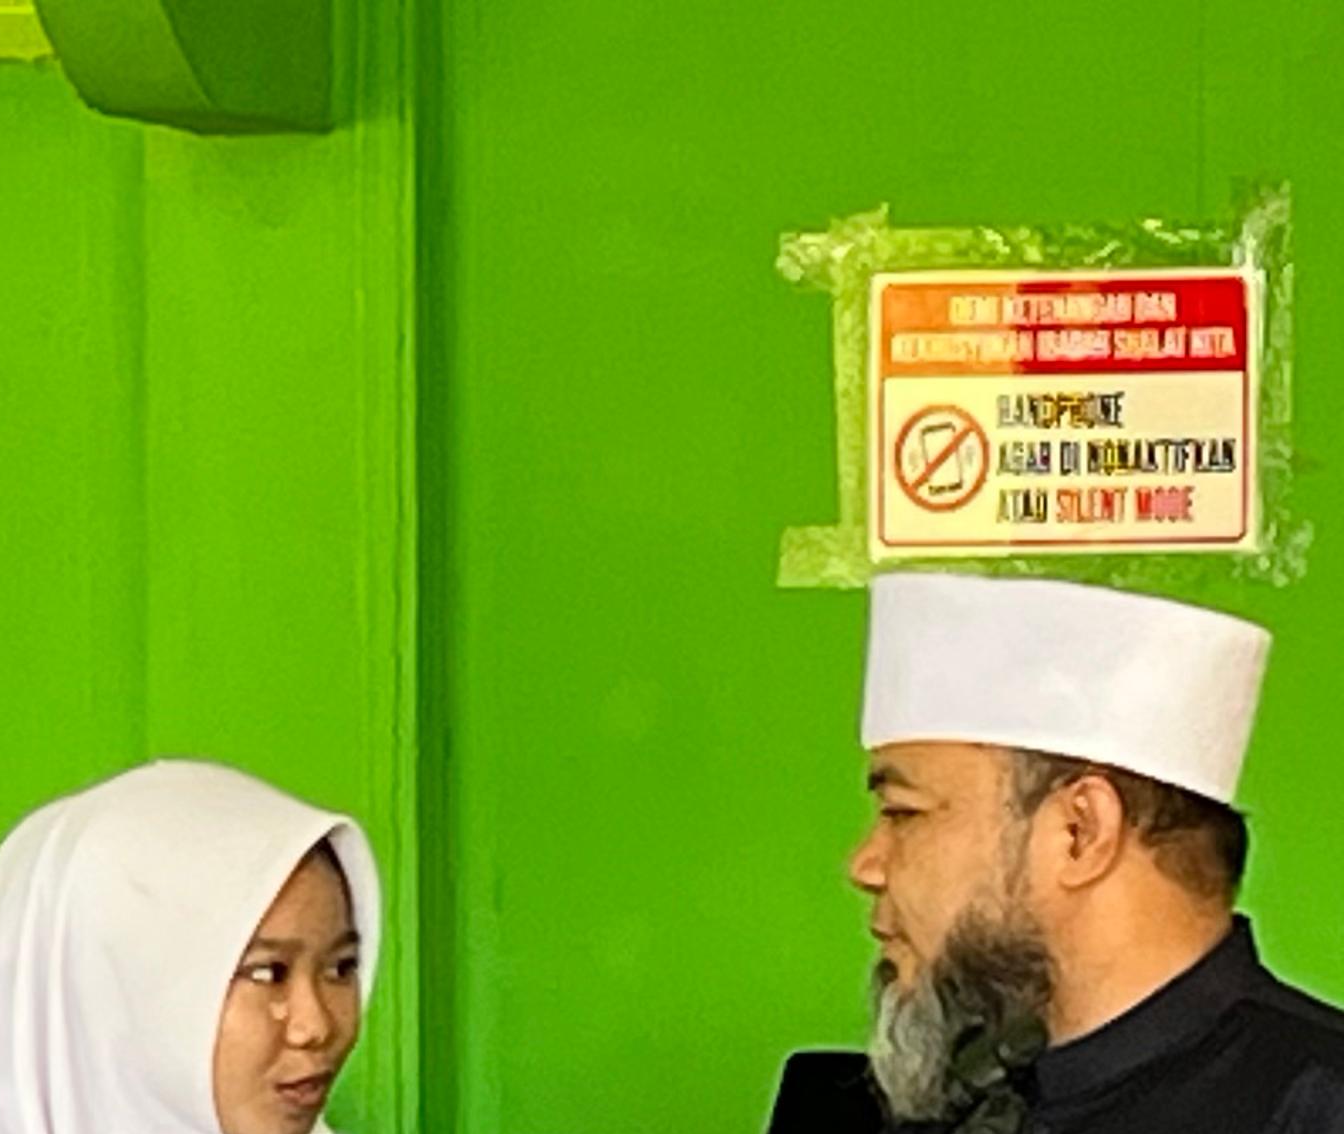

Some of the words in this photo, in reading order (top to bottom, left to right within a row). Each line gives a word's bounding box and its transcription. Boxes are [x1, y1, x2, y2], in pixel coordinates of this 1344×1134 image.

[996, 441, 1052, 476] AGAR
[1059, 440, 1082, 476] DI
[1086, 437, 1236, 476] NONAKTIFKAN
[996, 487, 1049, 523] ATAU
[1055, 487, 1126, 523] SILENT
[1134, 486, 1195, 522] MODE
